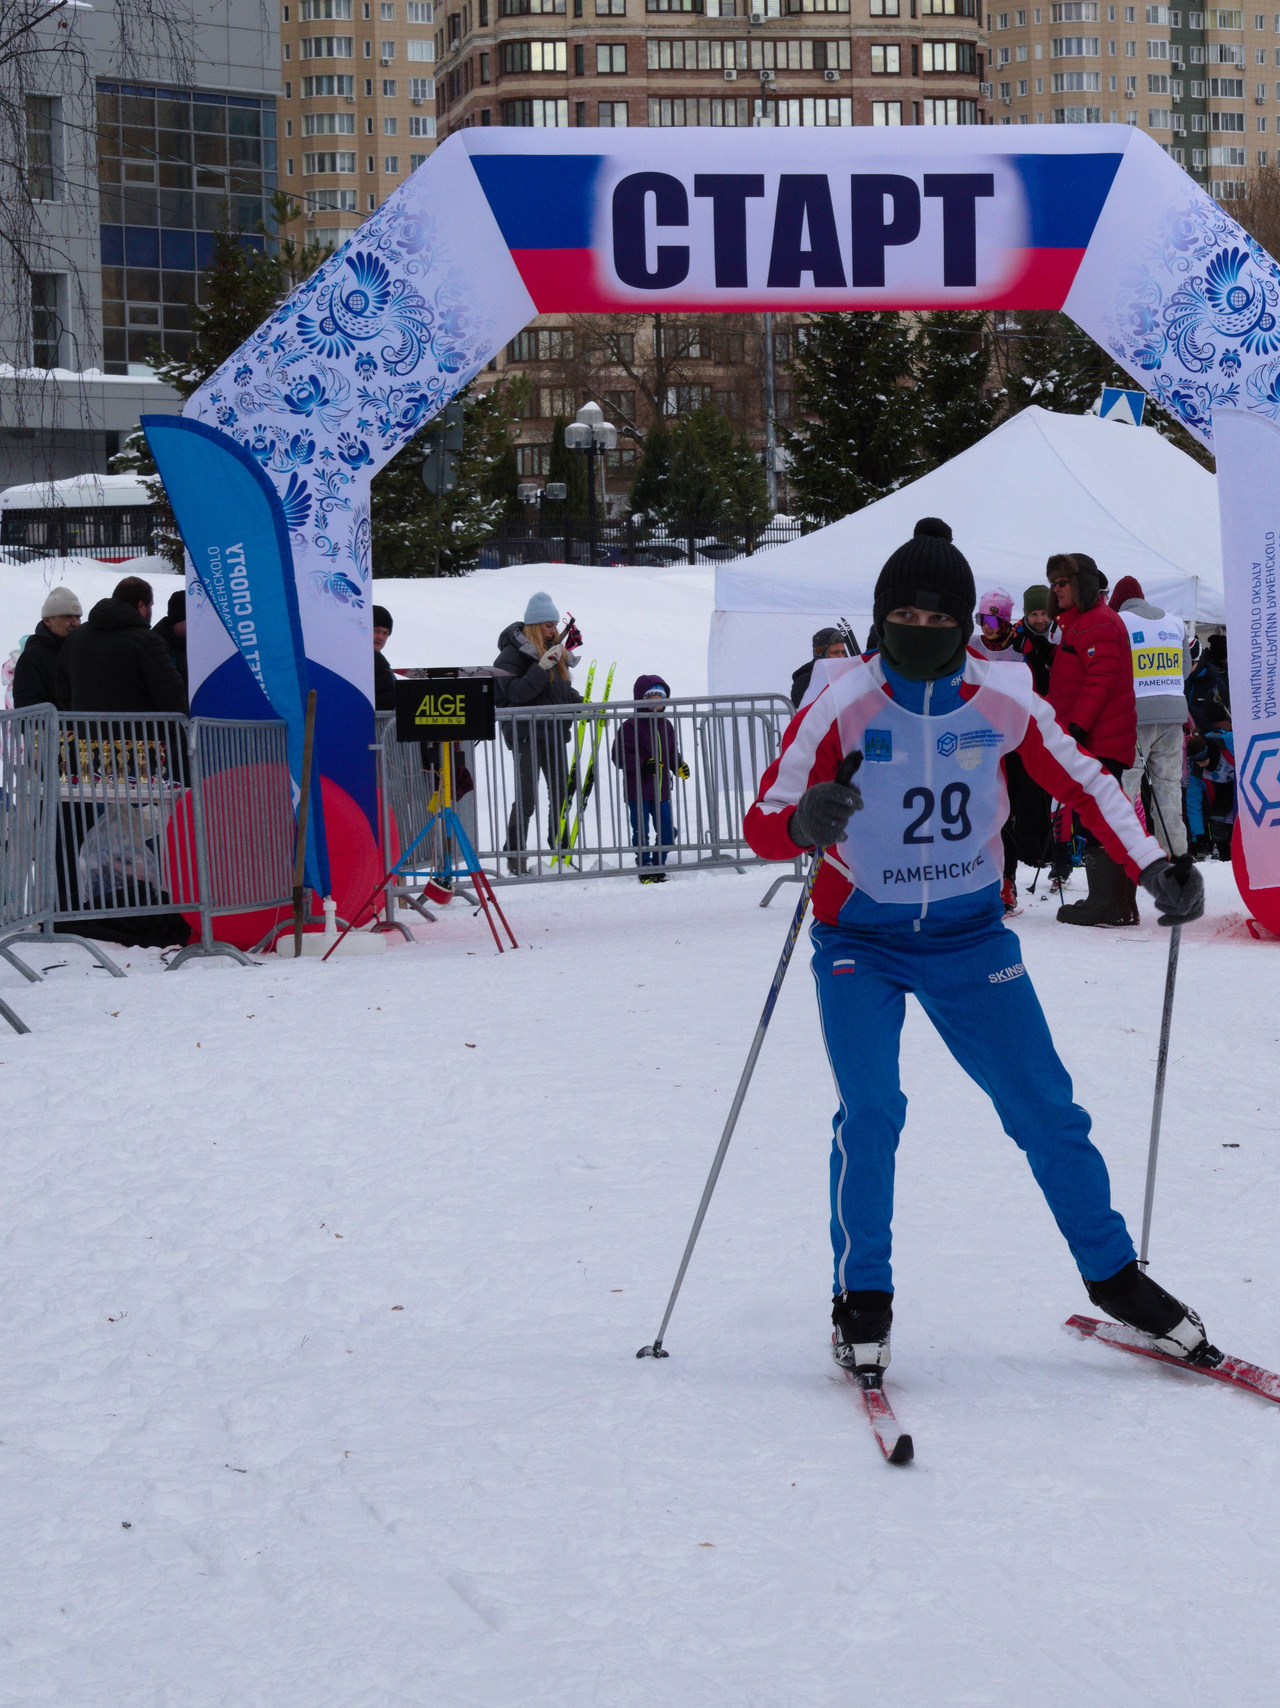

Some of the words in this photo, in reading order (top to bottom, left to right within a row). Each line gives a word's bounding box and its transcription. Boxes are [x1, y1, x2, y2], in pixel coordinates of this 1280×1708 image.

[612, 171, 996, 290] СТАРТ
[1137, 652, 1180, 671] СУДЬЯ
[1139, 678, 1182, 687] РАМЕНСКОЕ
[415, 694, 466, 715] ALGE
[903, 782, 972, 845] 29
